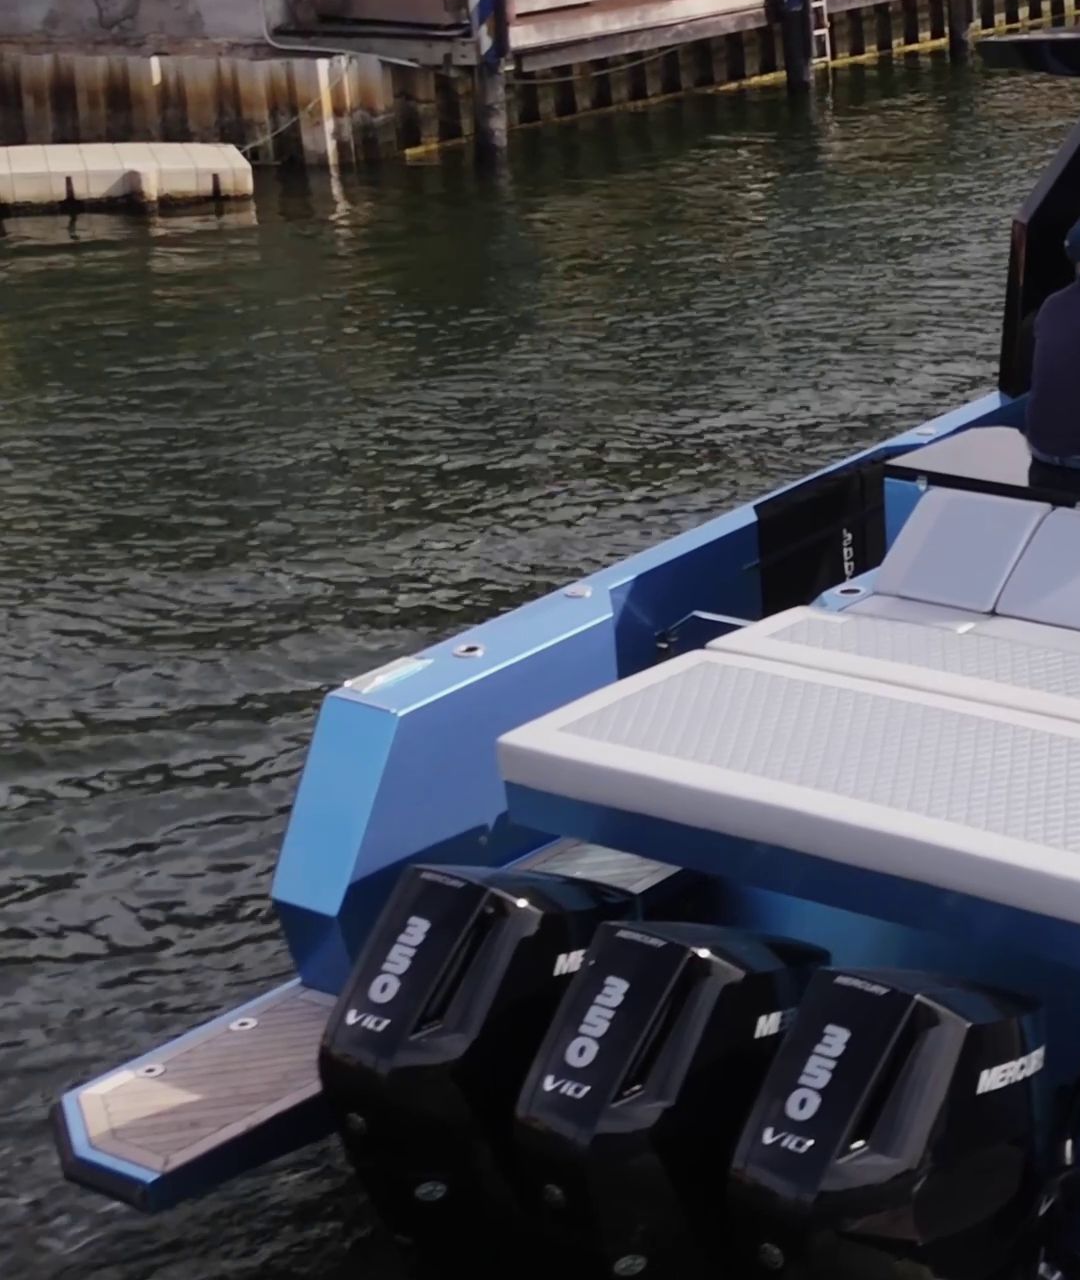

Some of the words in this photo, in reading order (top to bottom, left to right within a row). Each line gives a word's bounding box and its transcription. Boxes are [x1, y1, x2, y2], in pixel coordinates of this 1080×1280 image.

[367, 916, 432, 1004] 350
[345, 1008, 391, 1032] V10
[564, 975, 631, 1068] 350
[542, 1074, 592, 1099] V10
[784, 1023, 851, 1121] 350
[761, 1126, 815, 1154] V10
